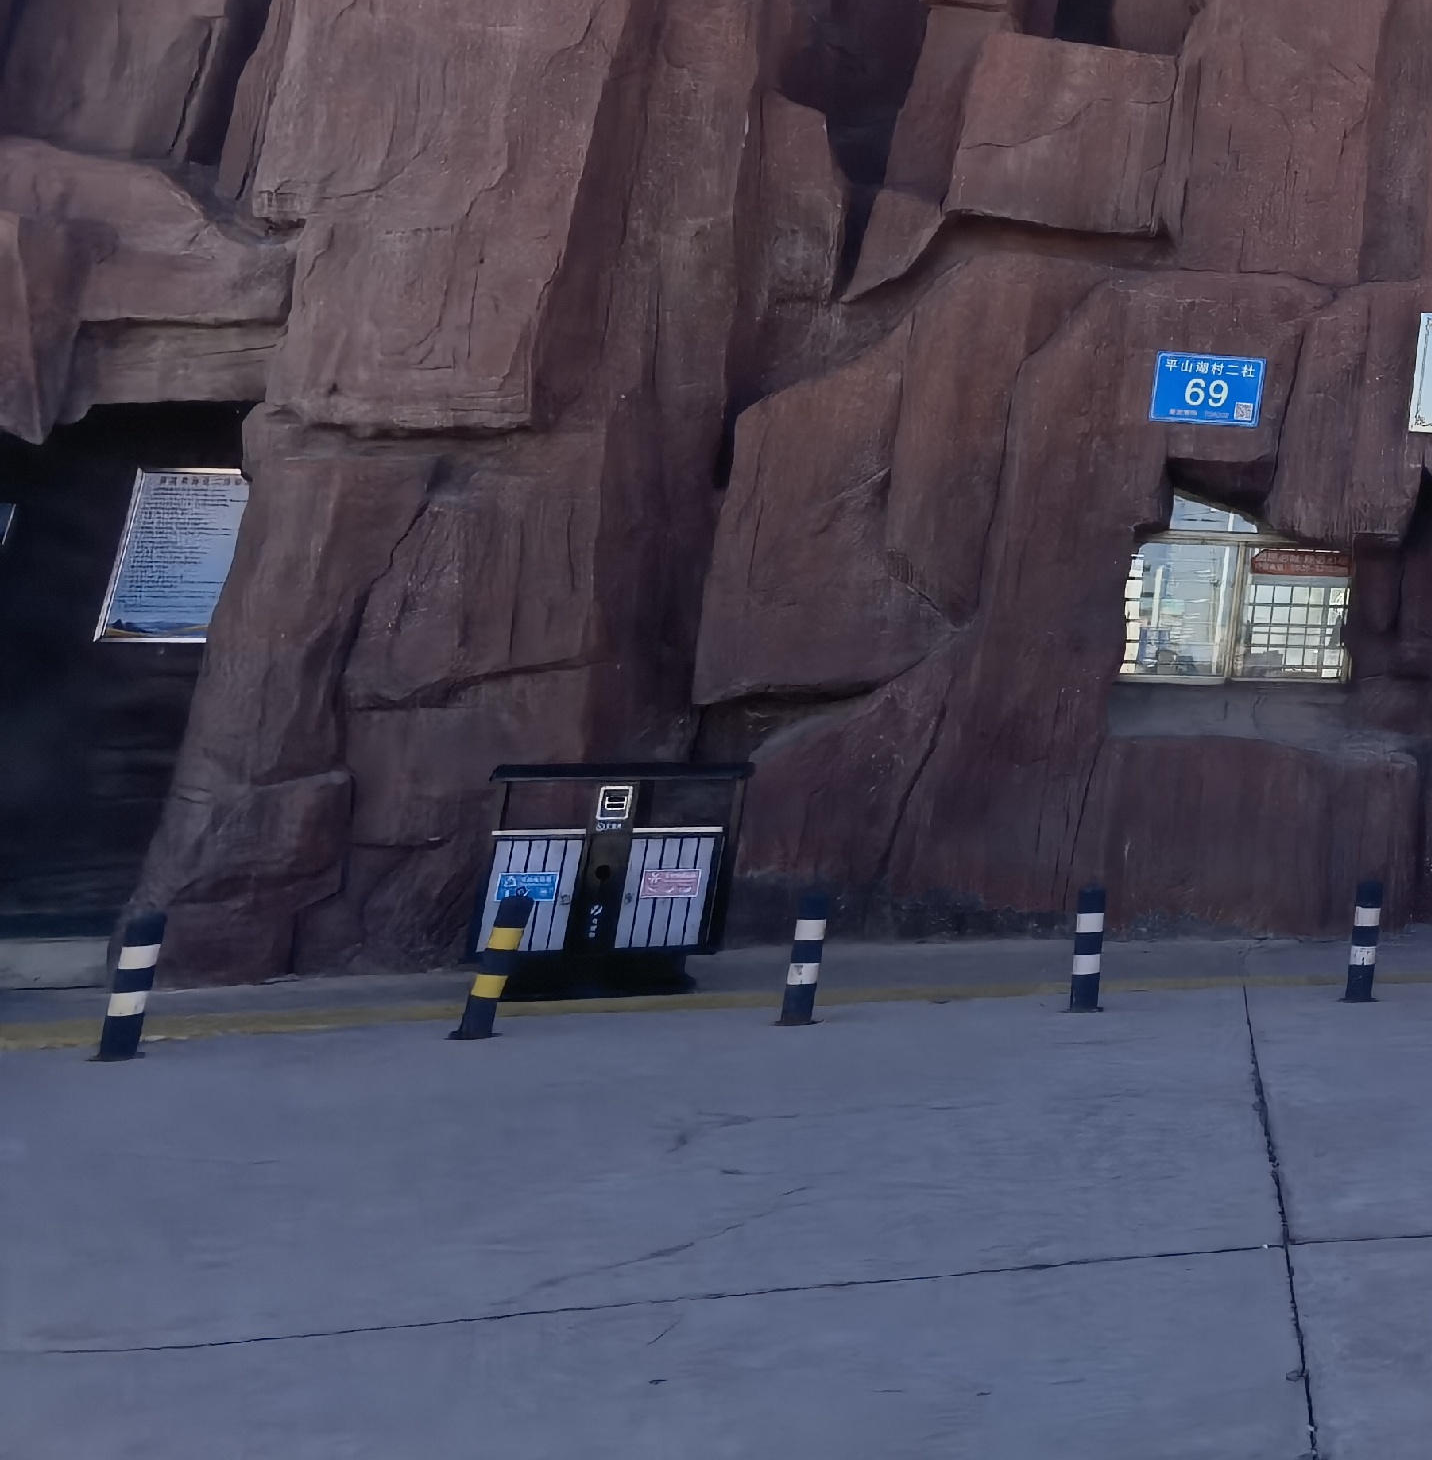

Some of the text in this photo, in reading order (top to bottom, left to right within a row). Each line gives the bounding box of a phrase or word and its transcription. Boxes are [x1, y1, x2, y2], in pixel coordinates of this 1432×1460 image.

[1165, 358, 1256, 378] 平山湖村二社
[1184, 378, 1229, 407] 69
